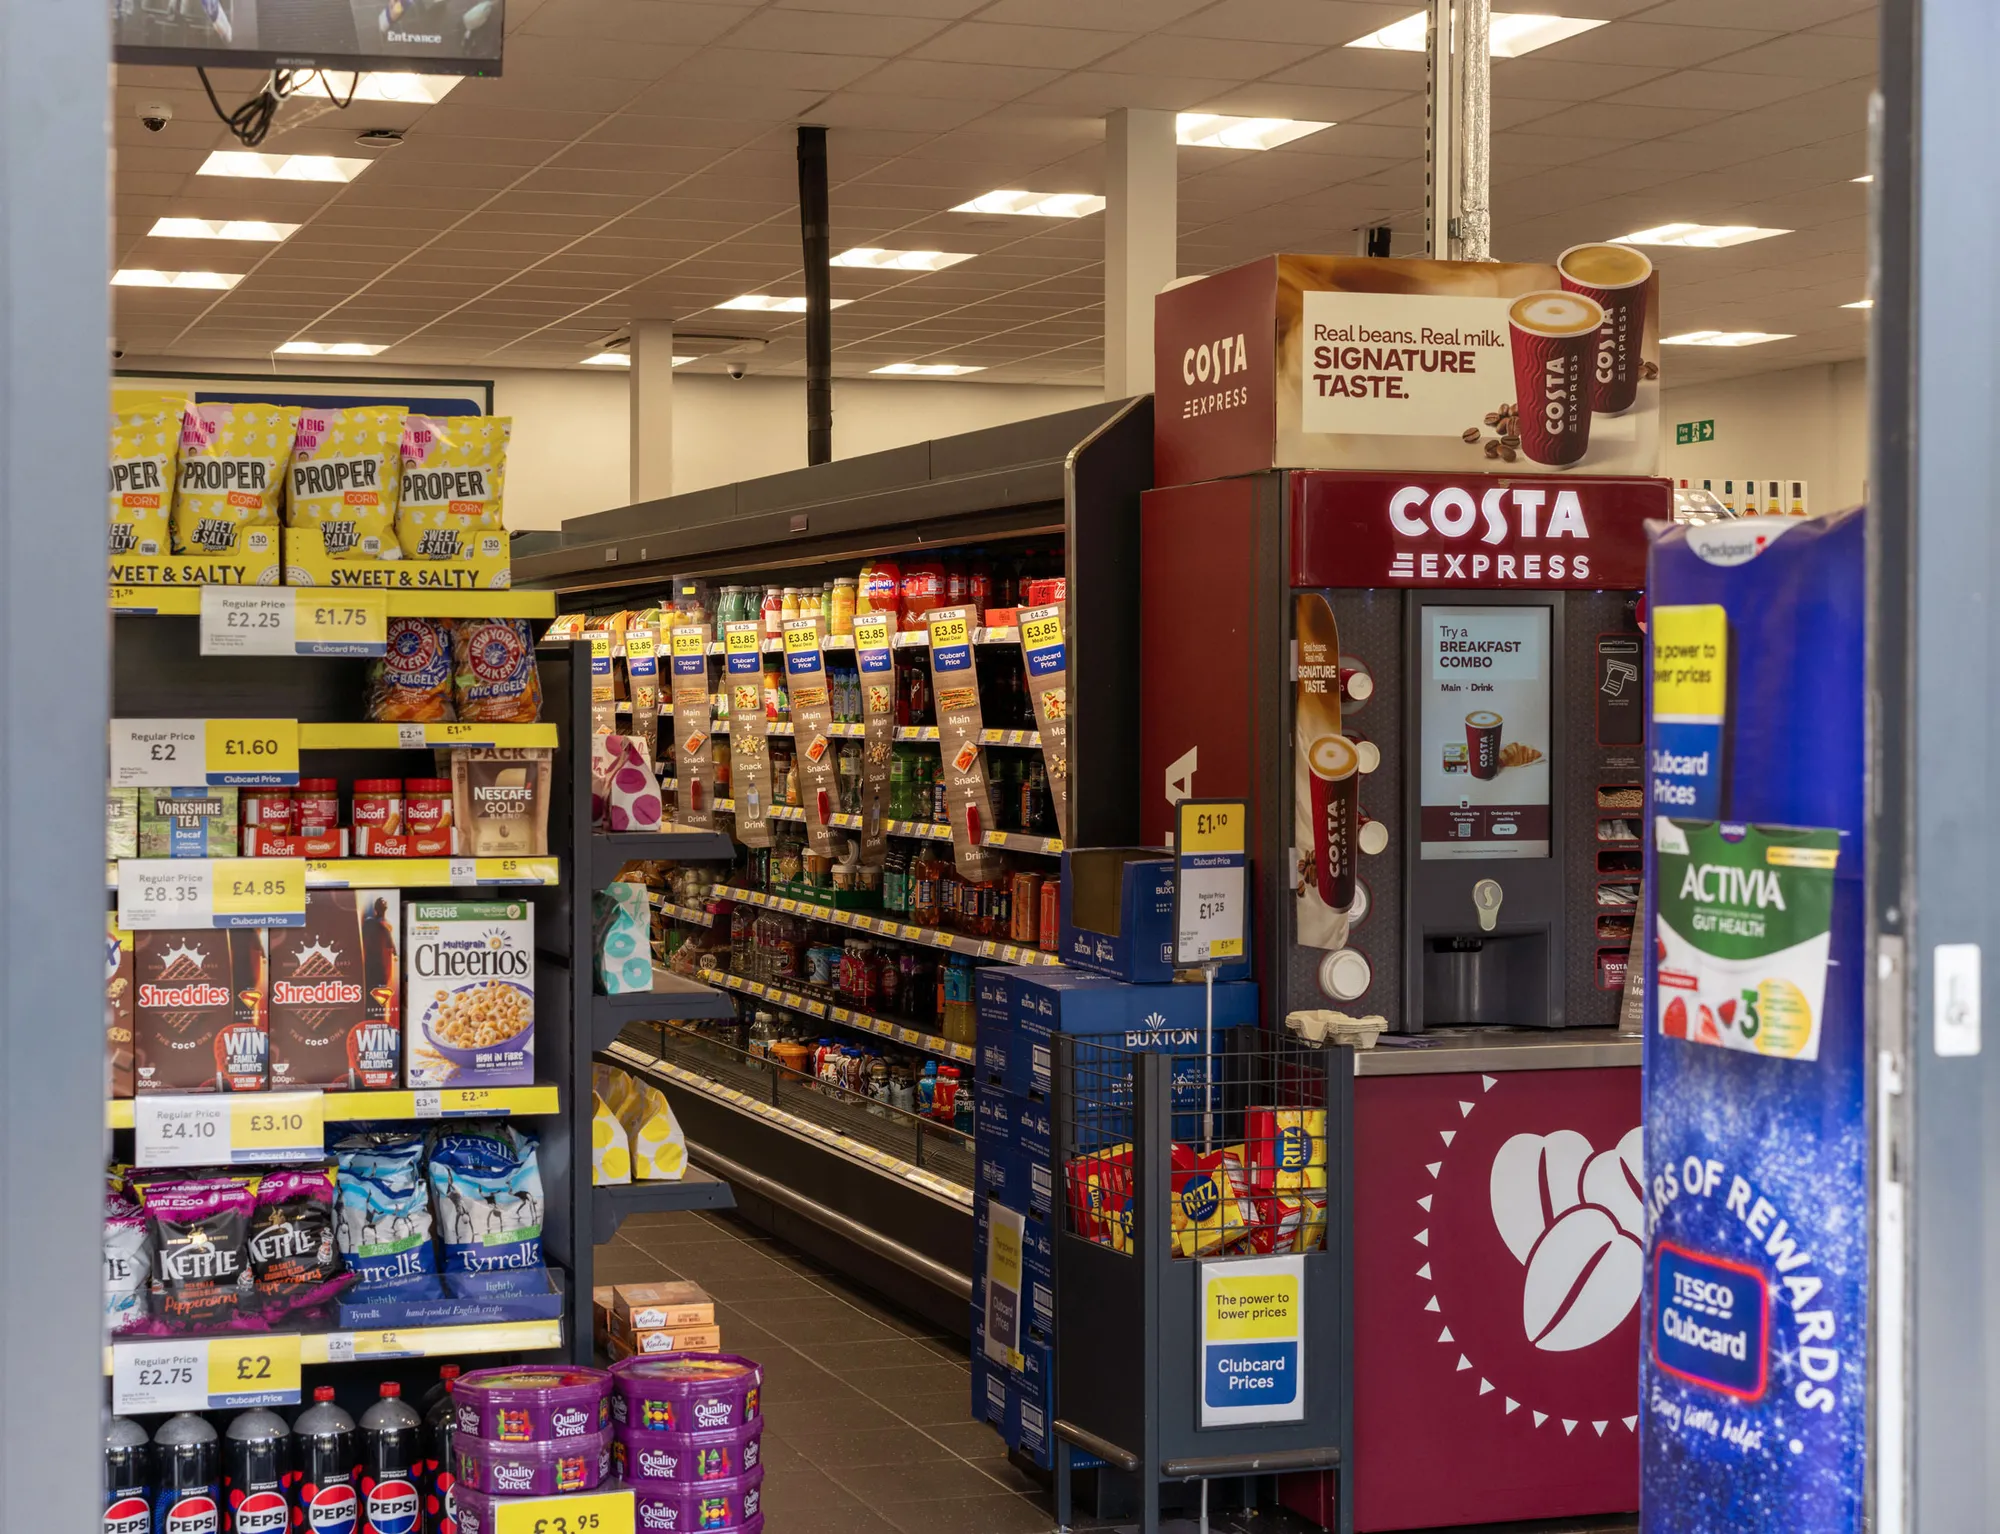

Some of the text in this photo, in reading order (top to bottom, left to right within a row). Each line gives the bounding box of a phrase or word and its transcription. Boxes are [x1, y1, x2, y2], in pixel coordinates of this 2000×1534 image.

[387, 31, 442, 44] Entrance
[1314, 324, 1504, 348] Real beans. Real milk.
[1618, 306, 1627, 371] EXPRESS
[1183, 334, 1248, 386] COSTA
[1313, 346, 1476, 374] SIGNATURE
[1313, 374, 1410, 400] TASTE.
[1569, 354, 1578, 422] EXPRESS
[1192, 386, 1248, 417] EXPRESS
[1546, 356, 1566, 435] COSTA
[307, 420, 325, 432] BIG
[1680, 426, 1688, 434] Fire
[1680, 434, 1688, 442] exit
[183, 461, 266, 489] PROPER
[346, 494, 378, 504] CORN
[1389, 486, 1590, 546] COSTA
[198, 518, 236, 533] SWEET
[250, 535, 267, 544] 130
[423, 529, 460, 542] SWEET
[1700, 542, 1752, 558] Checkpoint
[1420, 554, 1590, 580] EXPRESS
[331, 568, 480, 588] SWEET & SALTY
[222, 600, 286, 611] Regular Price
[227, 612, 280, 628] £2.25
[314, 608, 367, 626] £1.75
[1030, 610, 1048, 619] £4.25
[934, 624, 964, 637] £3.85
[1026, 622, 1058, 638] £3.85
[1440, 626, 1468, 640] Try a
[471, 629, 519, 657] NEW YORK
[1440, 640, 1522, 653] BREAKFAST
[1664, 643, 1716, 658] power to
[386, 651, 428, 670] BAKERY
[938, 651, 966, 660] Clubcard
[1440, 656, 1493, 668] COMBO
[1040, 660, 1057, 668] Price
[1298, 665, 1336, 678] SIGNATURE
[1441, 684, 1494, 692] Main Drink
[802, 712, 821, 720] Main
[872, 718, 887, 726] Main
[949, 715, 970, 725] Main
[131, 732, 196, 744] Regular Price
[150, 744, 176, 761] £2
[225, 739, 278, 755] £1.60
[470, 749, 526, 760] PACK
[1480, 736, 1488, 768] COSTA
[807, 764, 830, 772] Snack
[224, 775, 282, 784] Clubcard Price
[869, 774, 886, 782] Snack
[954, 775, 981, 786] Snack
[158, 801, 222, 816] YORKSHIRE
[356, 806, 385, 819] Biscoff
[485, 802, 526, 814] GOLD
[178, 816, 200, 828] TEA
[1197, 814, 1228, 834] £1.10
[176, 830, 202, 840] Decaf
[817, 830, 838, 840] Drink
[866, 838, 881, 848] Drink
[502, 861, 516, 870] £5
[1194, 857, 1230, 866] Clubcard Price
[144, 887, 198, 902] £8.35
[232, 881, 286, 896] £4.85
[1678, 862, 1786, 912] ACTIVIA
[1200, 902, 1224, 919] £1.25
[231, 916, 288, 926] Clubcard Price
[1692, 914, 1765, 938] GUT HEALTH
[443, 940, 486, 950] Multigrain
[415, 944, 528, 977] Cheerios
[139, 984, 230, 1008] Shreddies
[1740, 988, 1759, 1039] 3
[223, 1032, 266, 1056] WIN
[356, 1028, 398, 1052] WIN
[1125, 1028, 1198, 1047] BUXTON
[172, 1042, 196, 1050] COCO
[234, 1054, 257, 1064] FAMILY
[228, 1063, 262, 1072] HOLIDAYS
[162, 1122, 216, 1138] £4.10
[251, 1114, 302, 1131] £3.10
[1282, 1130, 1301, 1168] RITZ
[147, 1198, 204, 1208] WIN £200
[1183, 1181, 1217, 1216] RITZ
[159, 1242, 240, 1280] KETTLE
[486, 1280, 516, 1293] lightly
[1674, 1272, 1734, 1310] TESCO
[1682, 1156, 1725, 1198] OF
[1726, 1174, 1839, 1414] REWARDS
[1216, 1293, 1290, 1307] The power to
[406, 1304, 504, 1318] hand-cooked English crisps
[1218, 1307, 1288, 1320] lower prices
[1662, 1307, 1747, 1361] Clubcard
[134, 1356, 198, 1368] Regular Price
[237, 1356, 272, 1380] £2
[1218, 1356, 1286, 1374] Clubcard
[139, 1368, 192, 1386] £2.75
[1229, 1376, 1274, 1390] Prices
[694, 1402, 732, 1419] Quality
[698, 1416, 730, 1428] Street
[1684, 1406, 1720, 1437] little
[1722, 1420, 1764, 1454] helps
[639, 1453, 678, 1468] Quality
[498, 1478, 532, 1490] Street
[370, 1500, 416, 1514] PEPSI
[170, 1518, 216, 1532] PEPSI
[534, 1514, 600, 1534] £3.95
